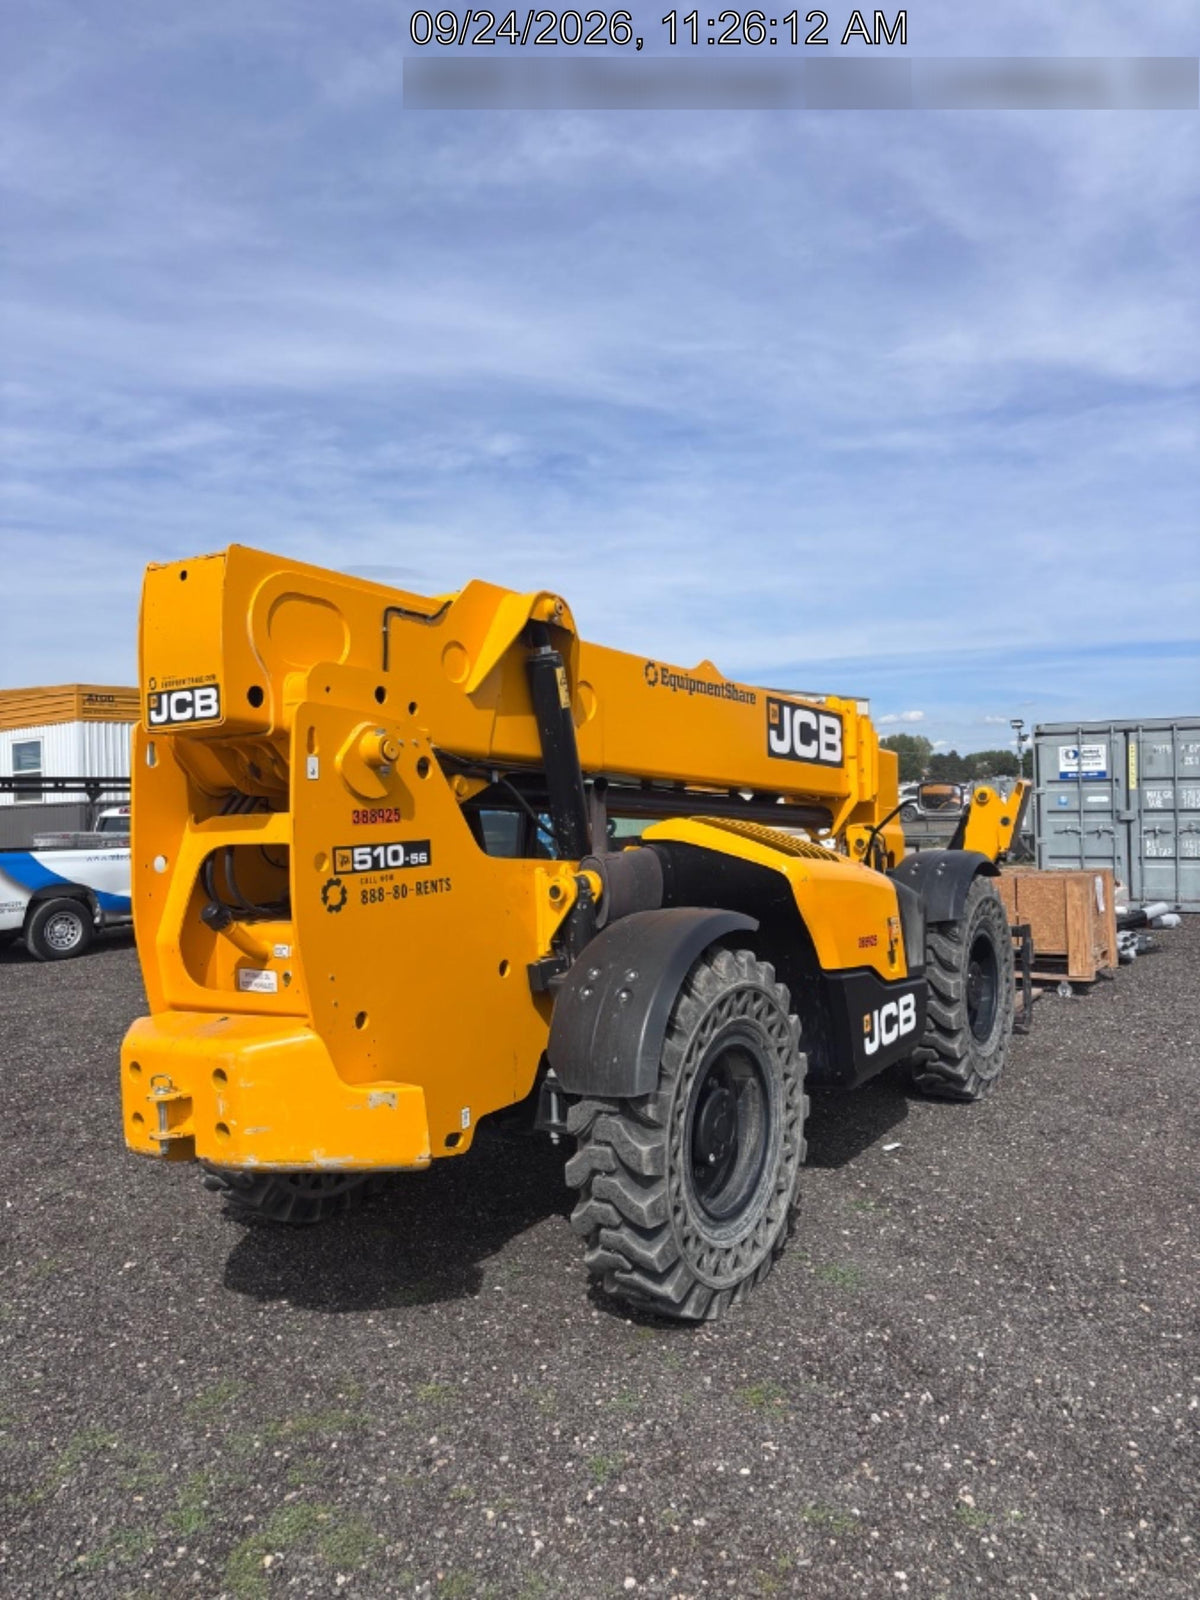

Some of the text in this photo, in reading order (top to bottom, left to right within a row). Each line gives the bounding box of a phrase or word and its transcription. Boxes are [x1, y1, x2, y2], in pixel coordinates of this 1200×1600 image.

[661, 666, 756, 704] EquipmentShare
[150, 687, 219, 723] JCB
[769, 706, 842, 763] JCB
[352, 808, 401, 825] 388925
[353, 844, 428, 870] 510-56
[360, 877, 452, 905] 888-80-RENTS
[864, 993, 917, 1056] JCB
